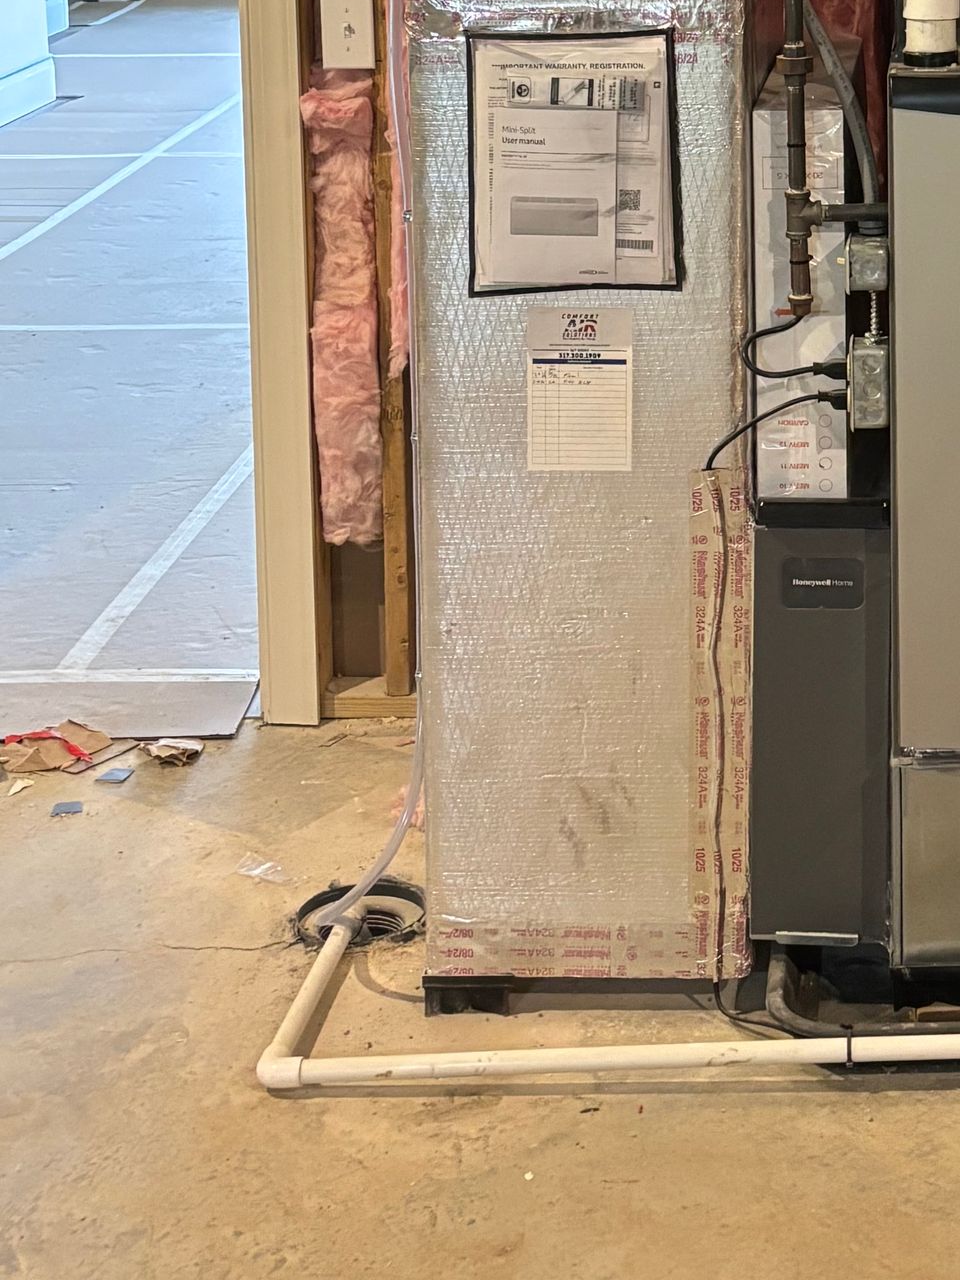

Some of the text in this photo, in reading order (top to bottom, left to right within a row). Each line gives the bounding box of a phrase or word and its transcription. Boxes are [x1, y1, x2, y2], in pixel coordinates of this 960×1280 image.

[502, 137, 546, 145] User manual
[692, 488, 703, 512] 10/25
[729, 486, 740, 512] 10/25
[792, 578, 831, 587] Honeywell
[695, 605, 705, 633] 324A
[733, 604, 743, 633] 324A
[698, 766, 708, 794] 324A
[734, 766, 744, 794] 324A
[695, 847, 706, 873] 10/25
[731, 847, 742, 873] 10/25
[446, 949, 474, 958] 08/24
